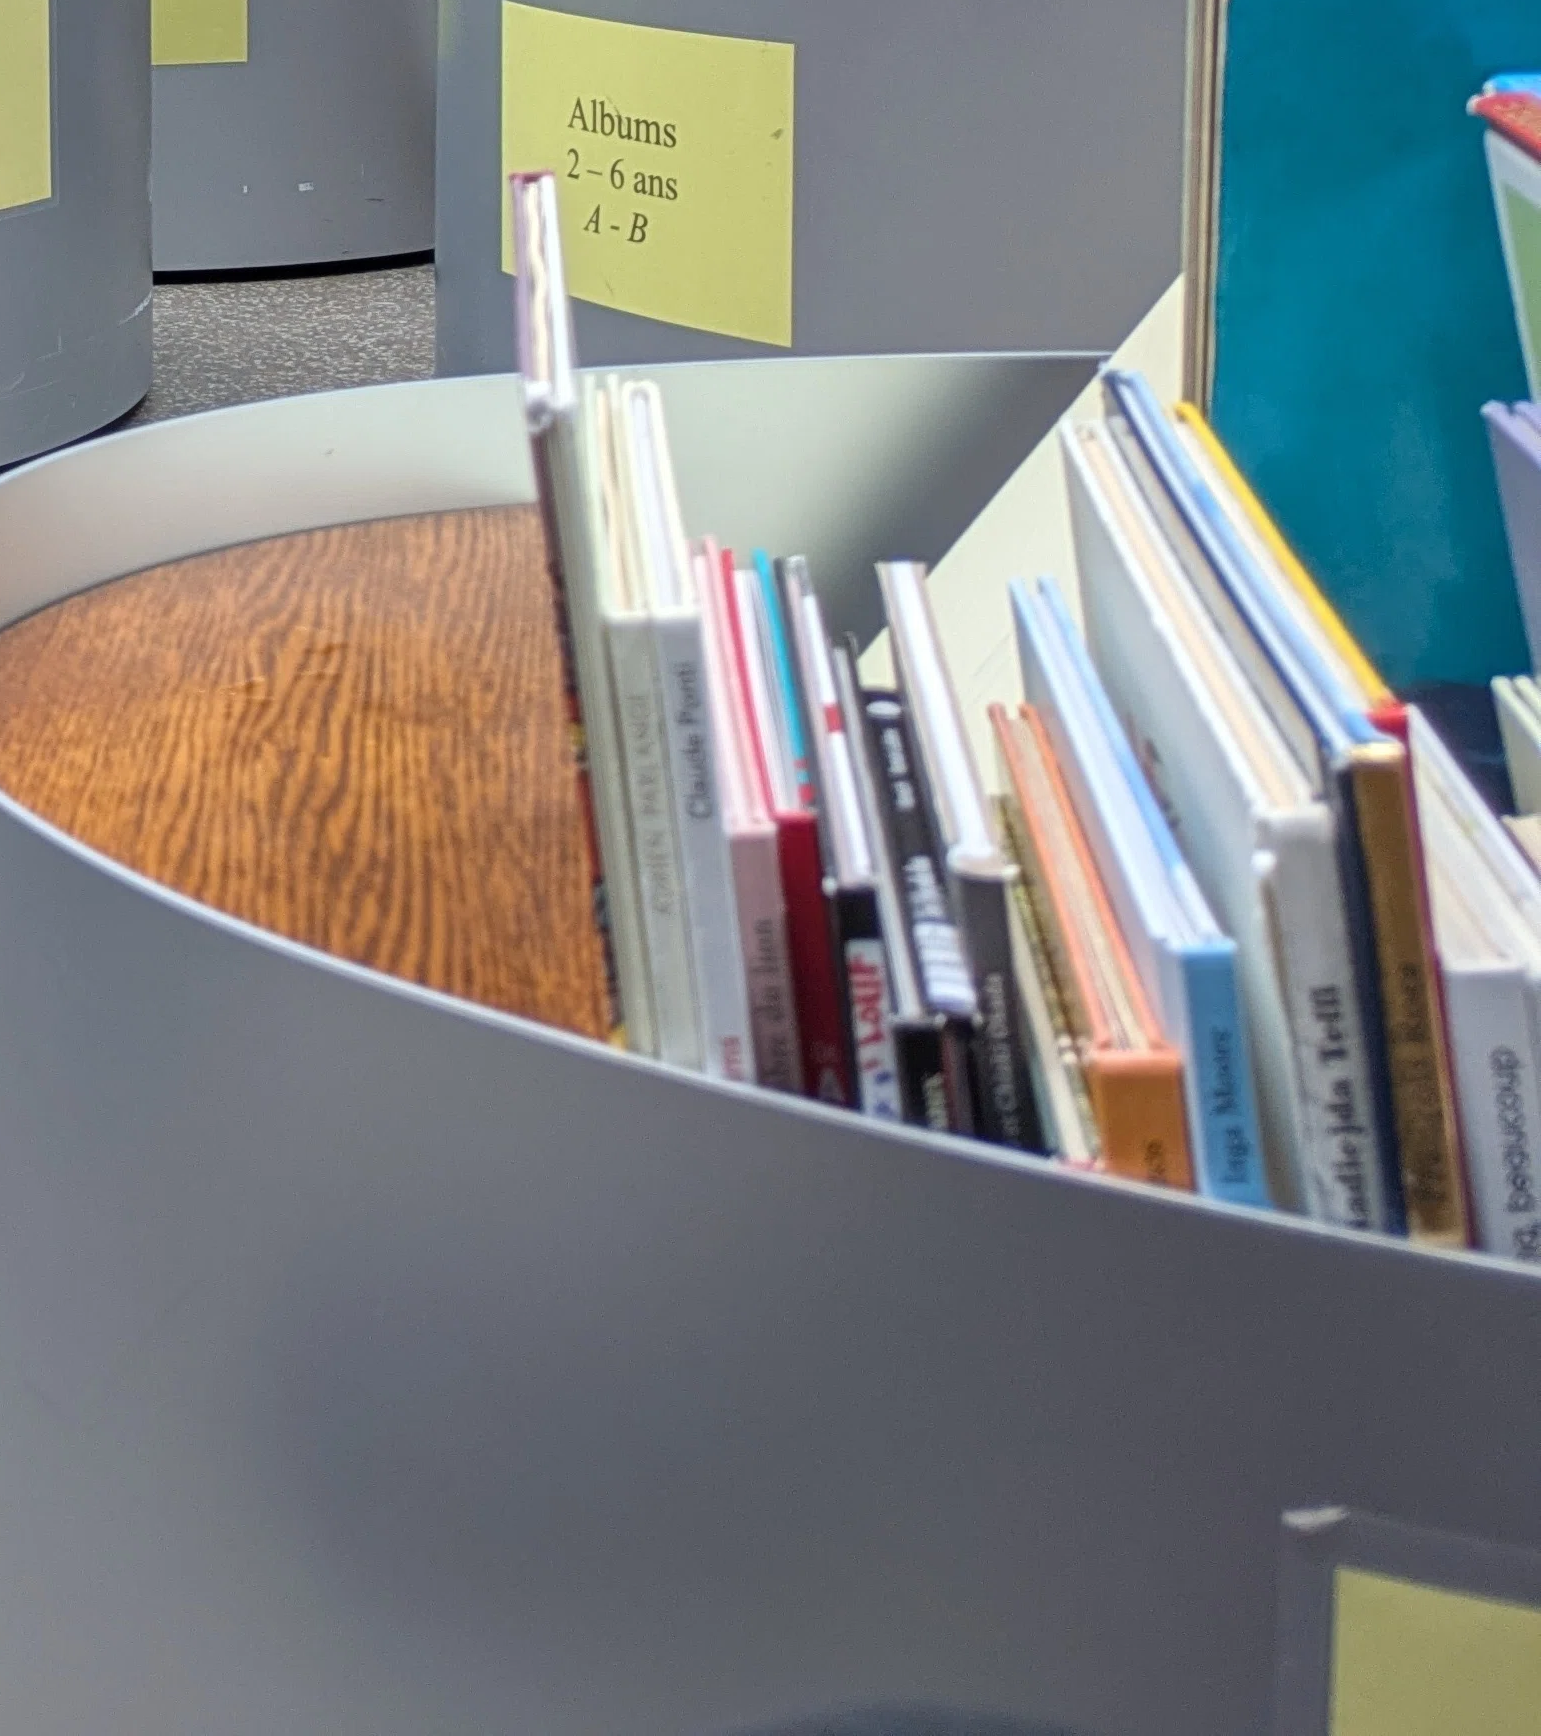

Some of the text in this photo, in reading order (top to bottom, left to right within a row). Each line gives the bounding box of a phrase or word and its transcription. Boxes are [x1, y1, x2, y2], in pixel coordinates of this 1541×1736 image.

[567, 96, 678, 148] Albums
[567, 148, 580, 180] 2
[610, 158, 625, 190] 6
[633, 170, 679, 201] ans
[583, 204, 601, 234] A
[627, 212, 649, 244] B
[673, 662, 714, 820] Claude Ponti
[1490, 1044, 1534, 1214] beaucoup
